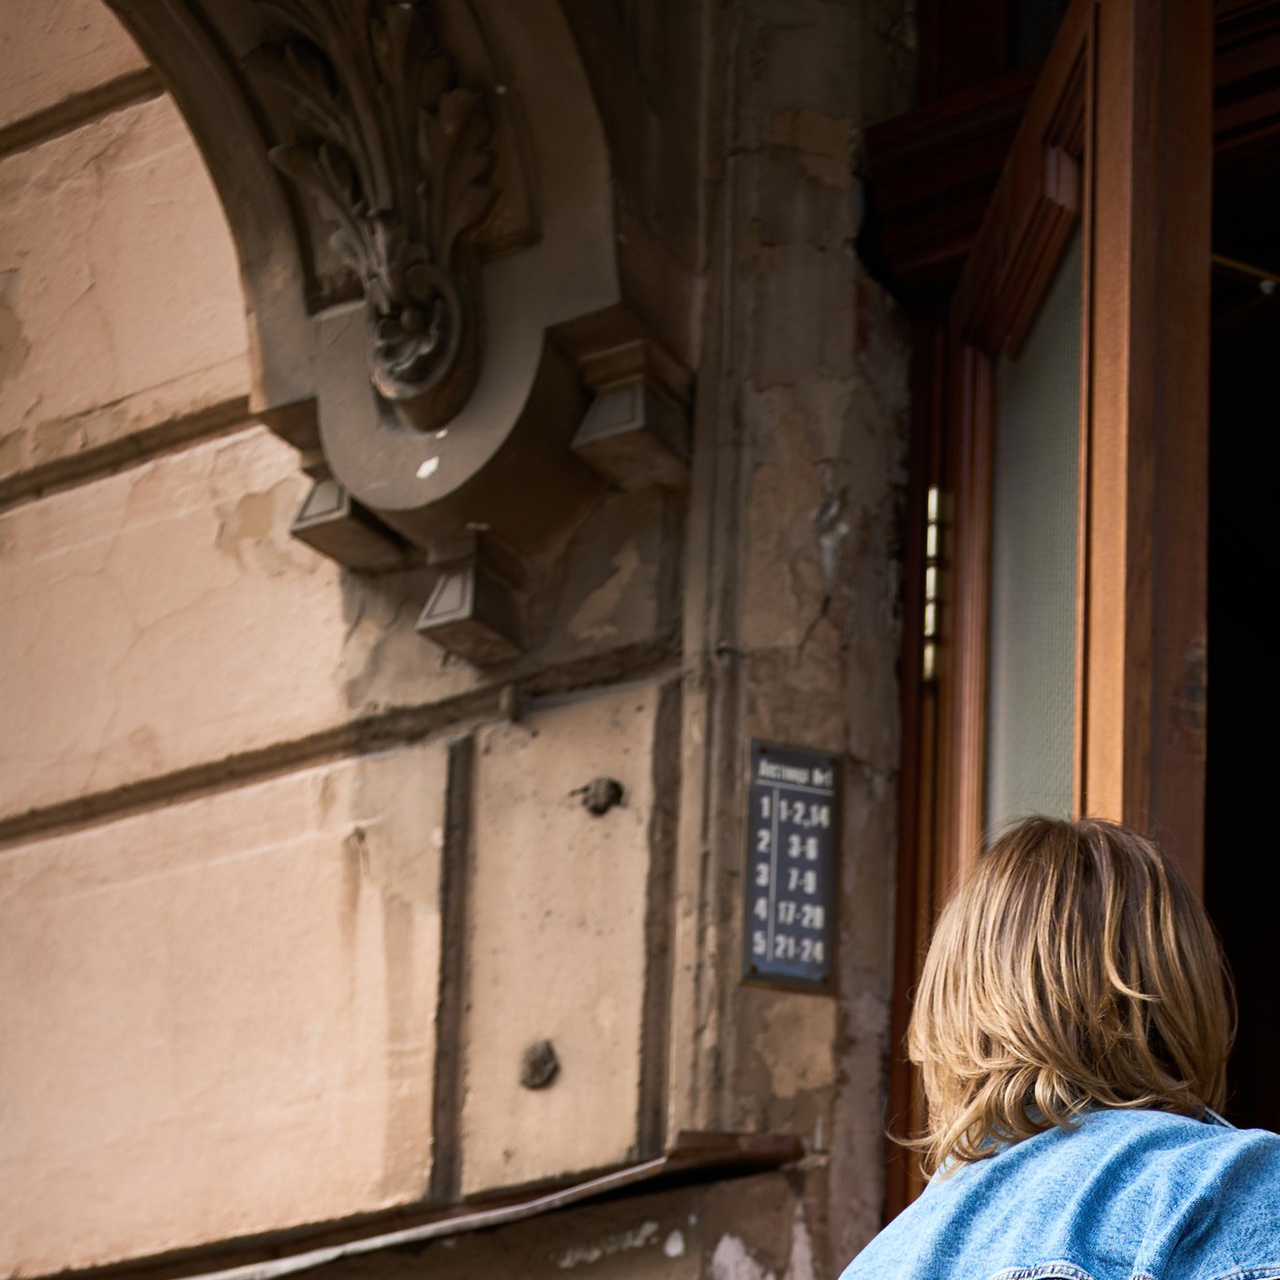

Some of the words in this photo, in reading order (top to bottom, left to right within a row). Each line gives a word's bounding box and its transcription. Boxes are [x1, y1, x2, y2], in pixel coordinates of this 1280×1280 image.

[761, 795, 770, 819] 1
[757, 828, 771, 853] 2
[756, 862, 769, 887] 3
[754, 897, 768, 920] 4
[753, 931, 766, 955] 5
